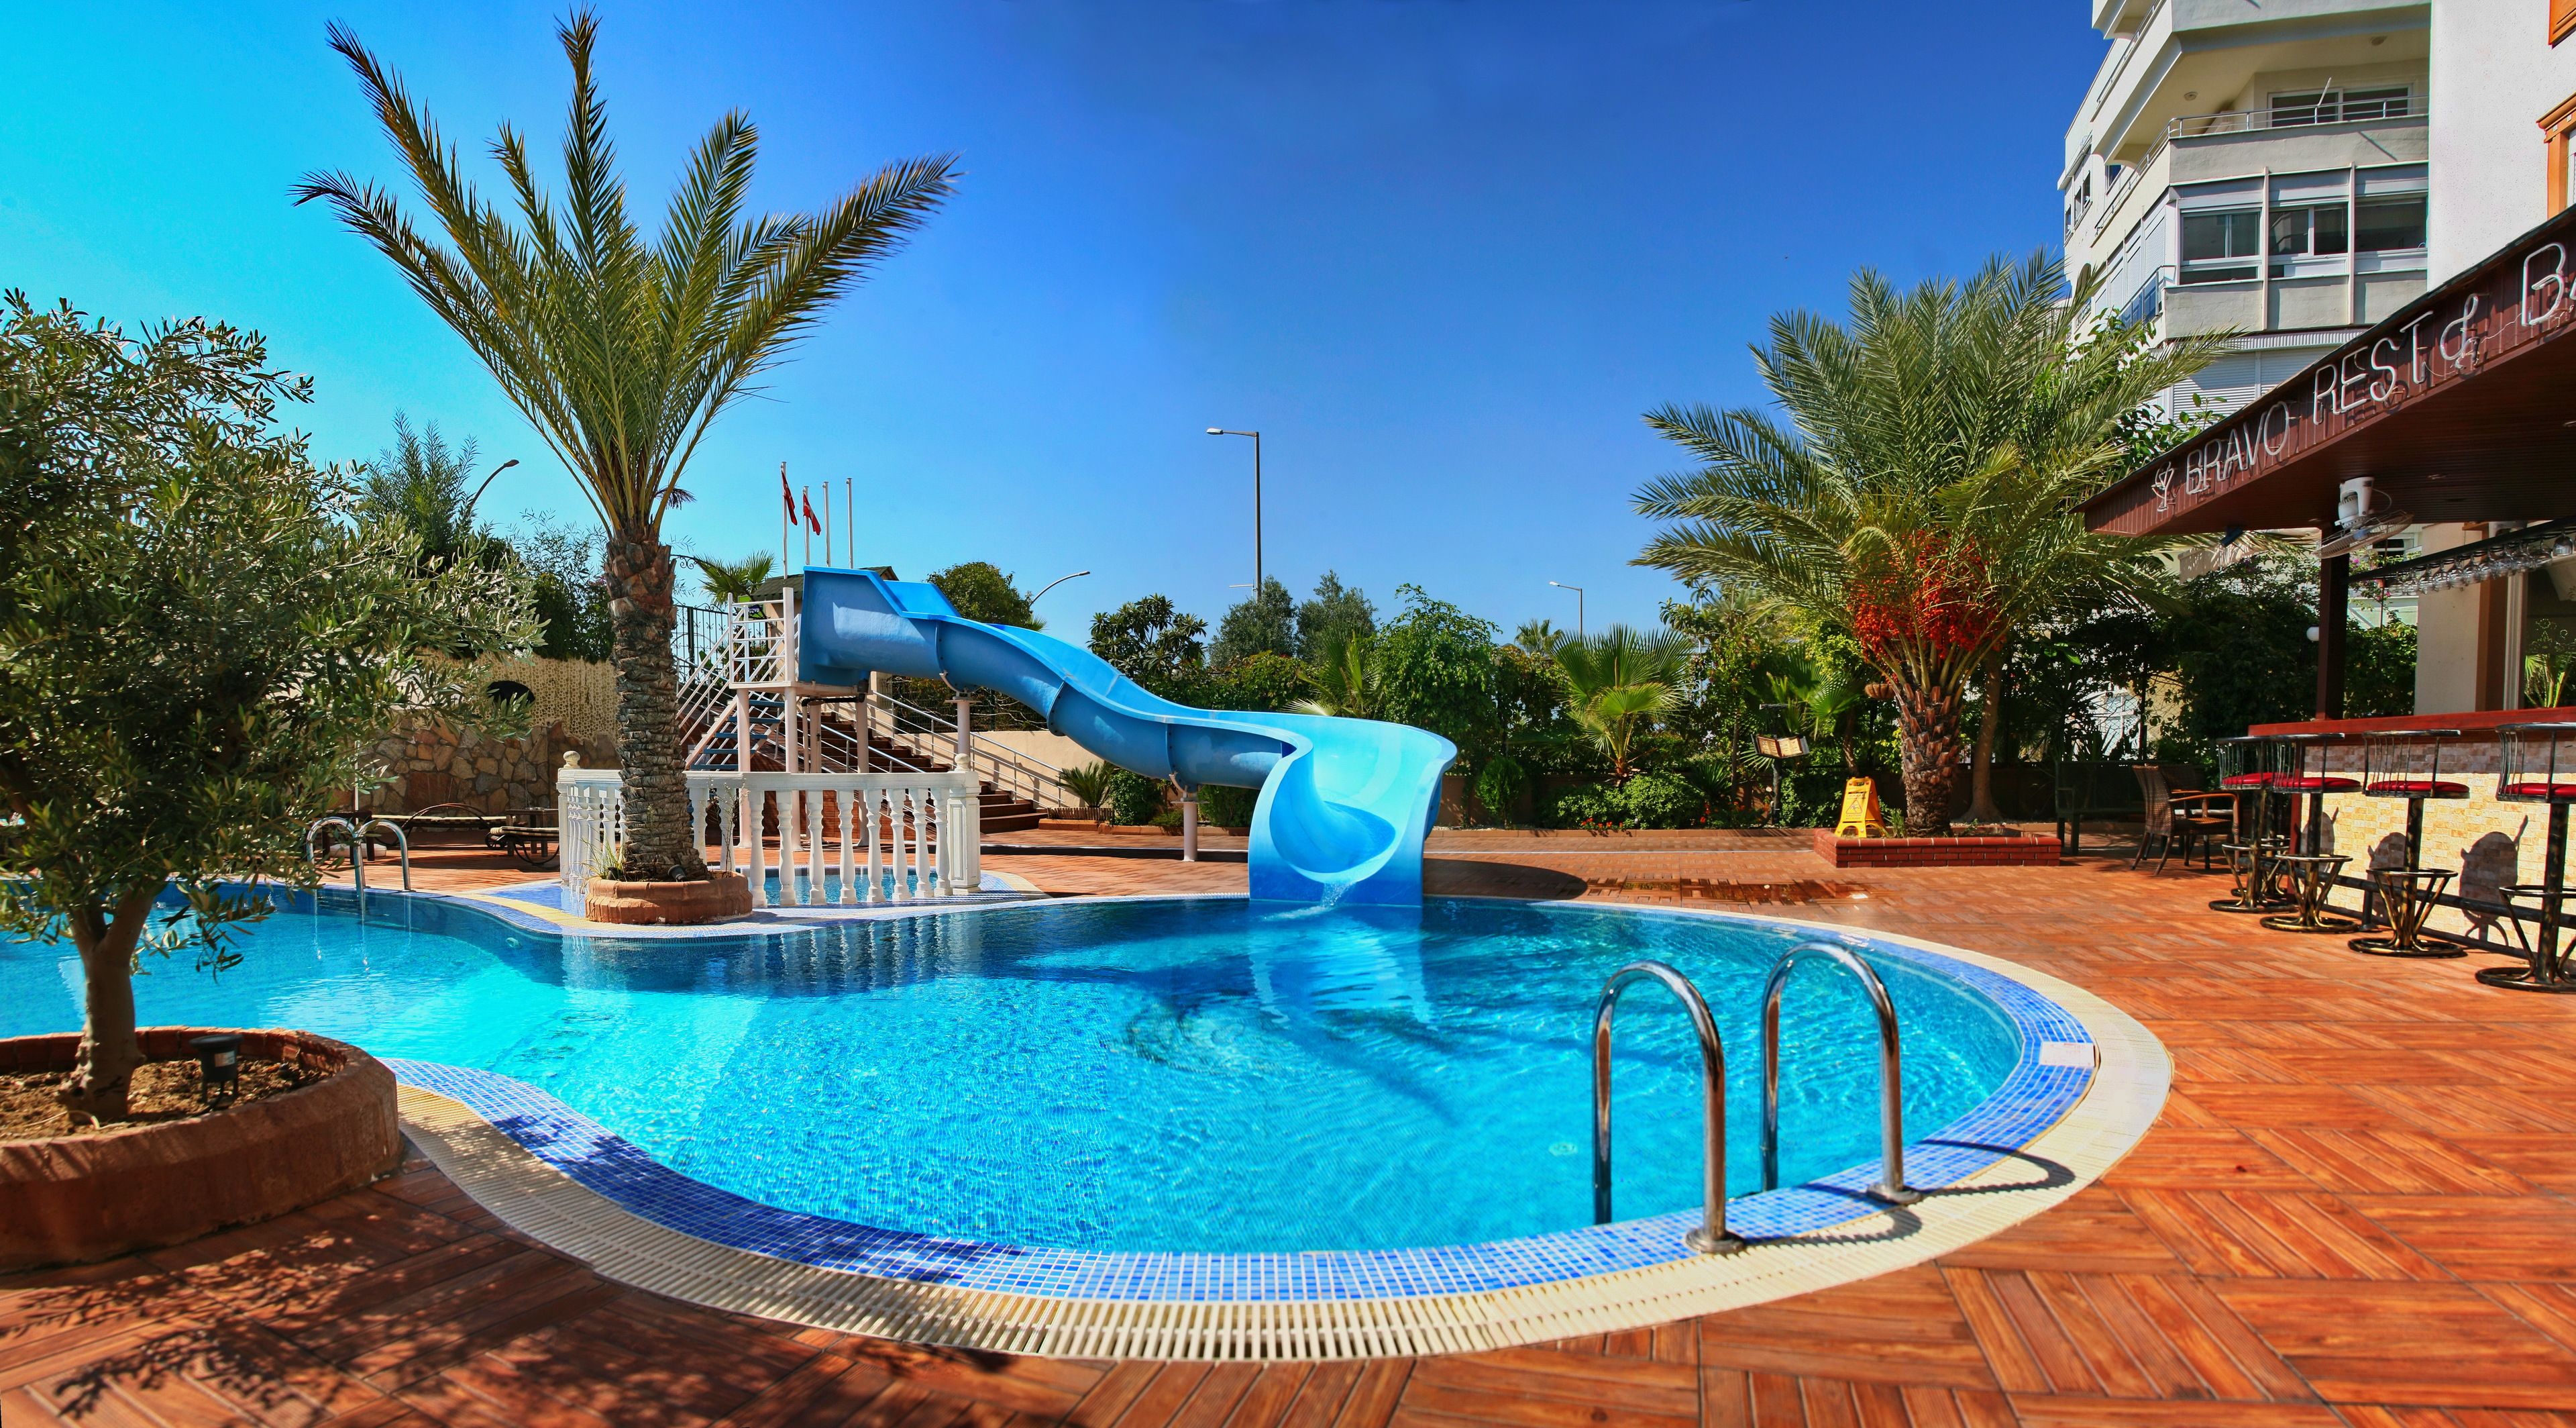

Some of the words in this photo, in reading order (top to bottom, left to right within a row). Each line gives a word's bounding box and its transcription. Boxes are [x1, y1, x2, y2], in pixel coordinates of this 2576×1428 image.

[2186, 401, 2290, 495] BRAVO
[2313, 311, 2433, 425] REST
[2522, 242, 2576, 326] B
